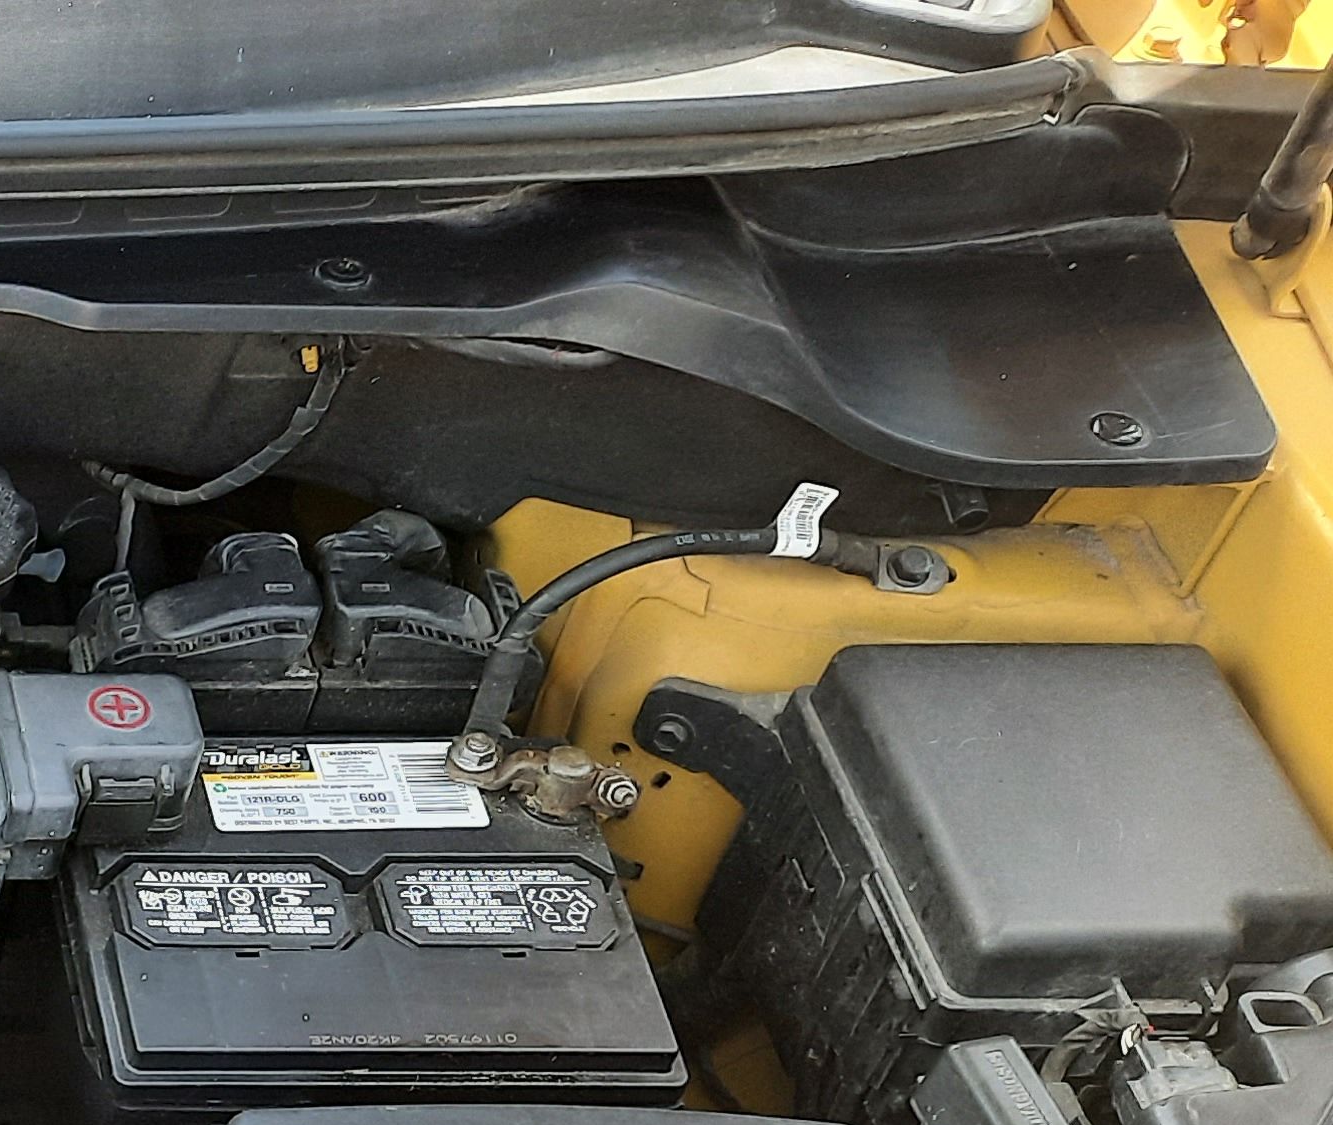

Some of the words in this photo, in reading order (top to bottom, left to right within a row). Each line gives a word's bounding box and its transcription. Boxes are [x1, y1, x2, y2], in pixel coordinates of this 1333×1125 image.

[203, 750, 302, 766] Duralast
[359, 792, 387, 802] 600
[158, 871, 230, 884] DANGER
[247, 872, 312, 884] POISON
